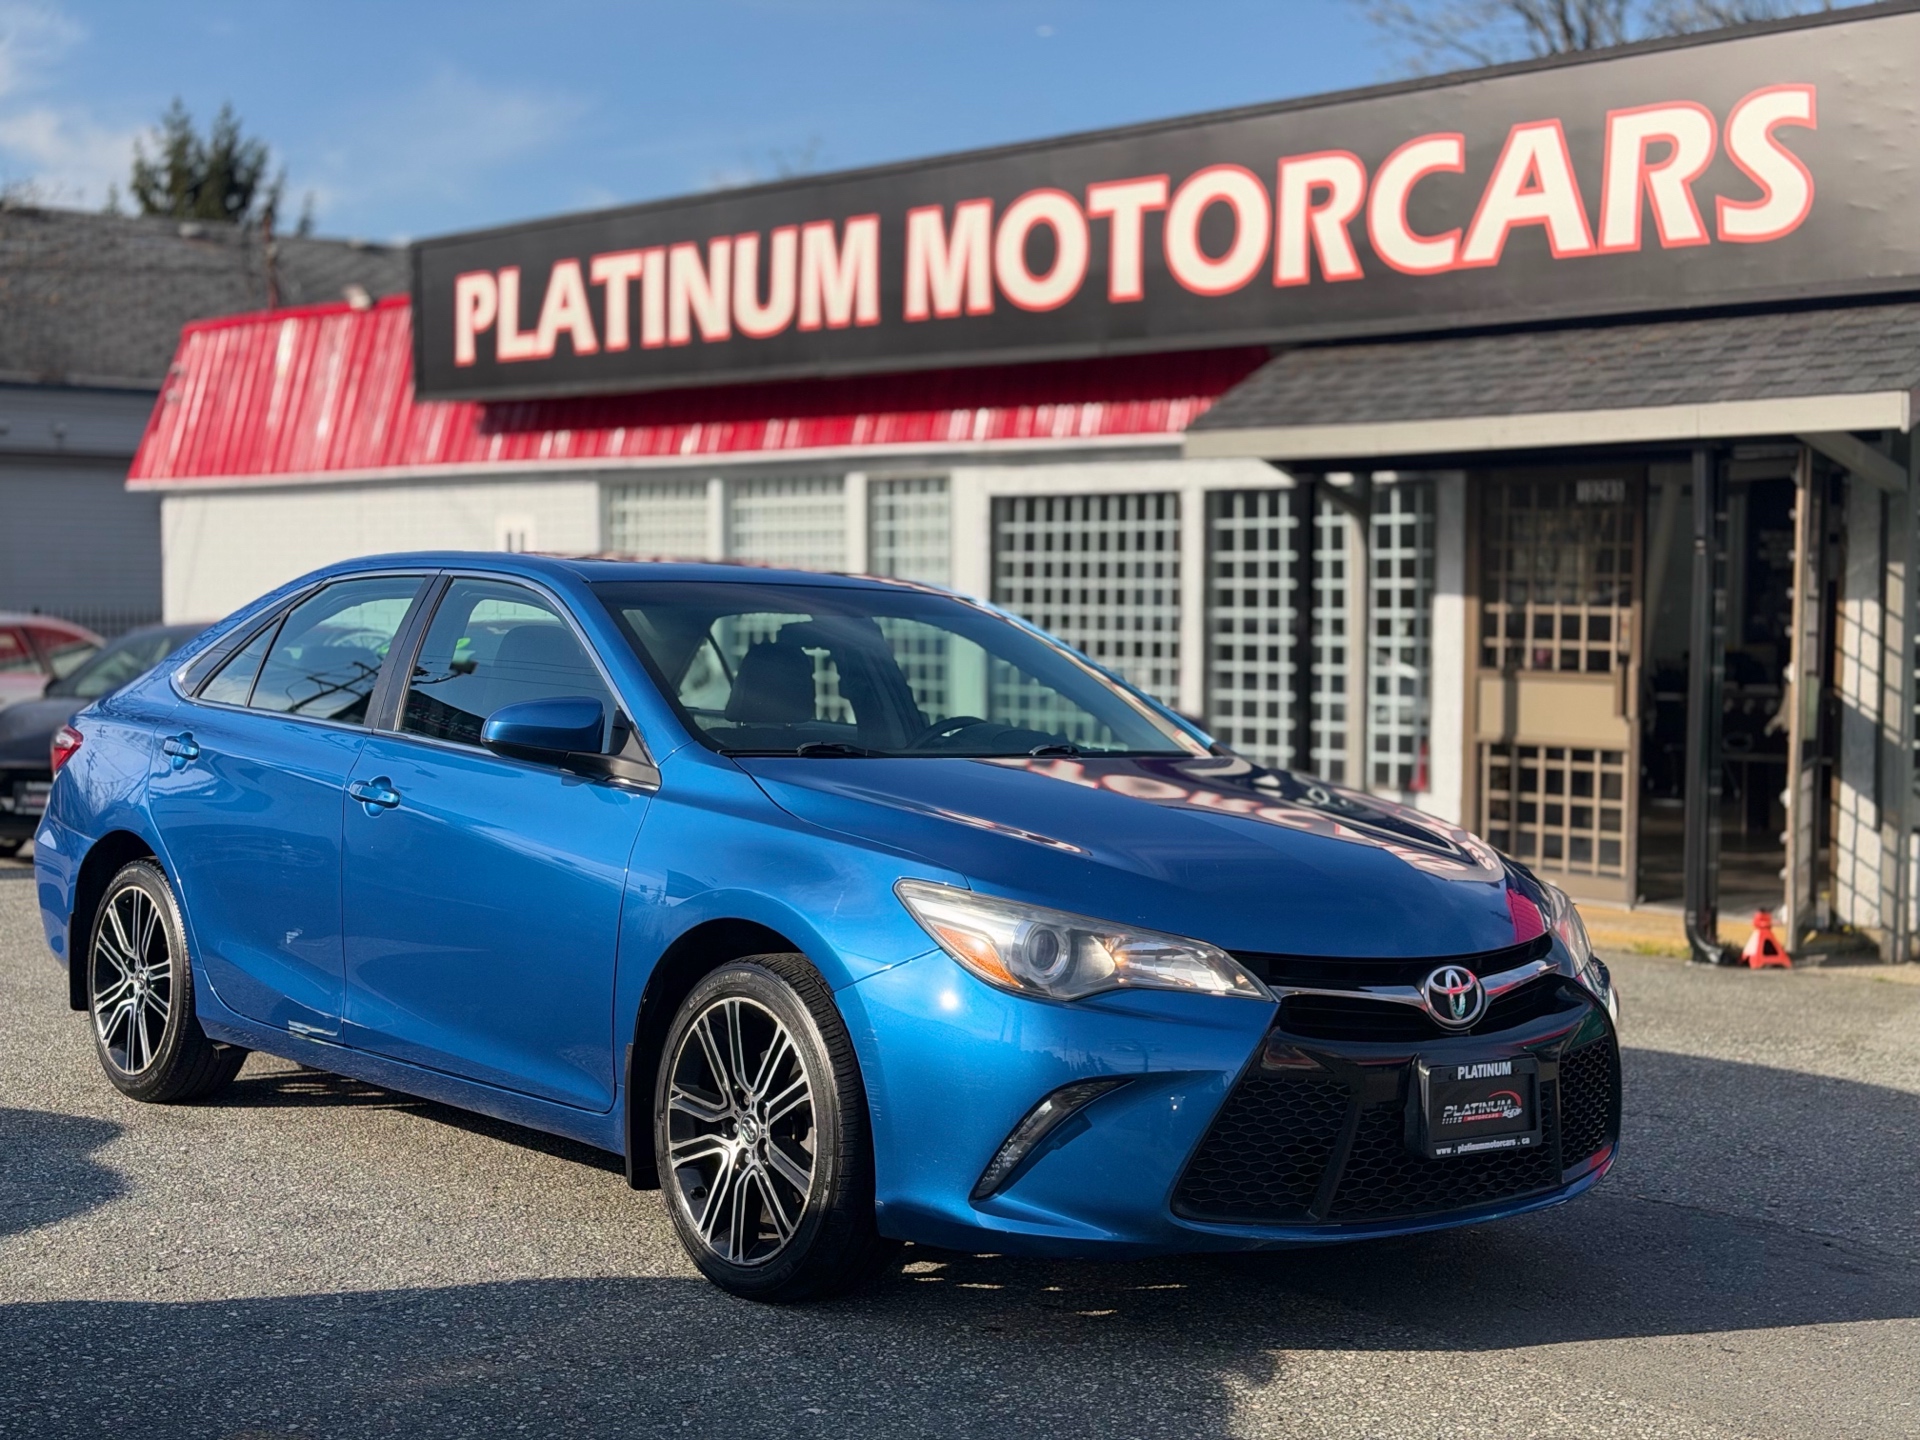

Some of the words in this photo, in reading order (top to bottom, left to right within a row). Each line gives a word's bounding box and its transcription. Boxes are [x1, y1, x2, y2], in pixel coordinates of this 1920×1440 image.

[454, 213, 881, 367] PLATINUM
[904, 83, 1817, 320] MOTORCARS
[1457, 1061, 1512, 1080] PLATINUM
[1443, 1099, 1512, 1118] PLATINUM
